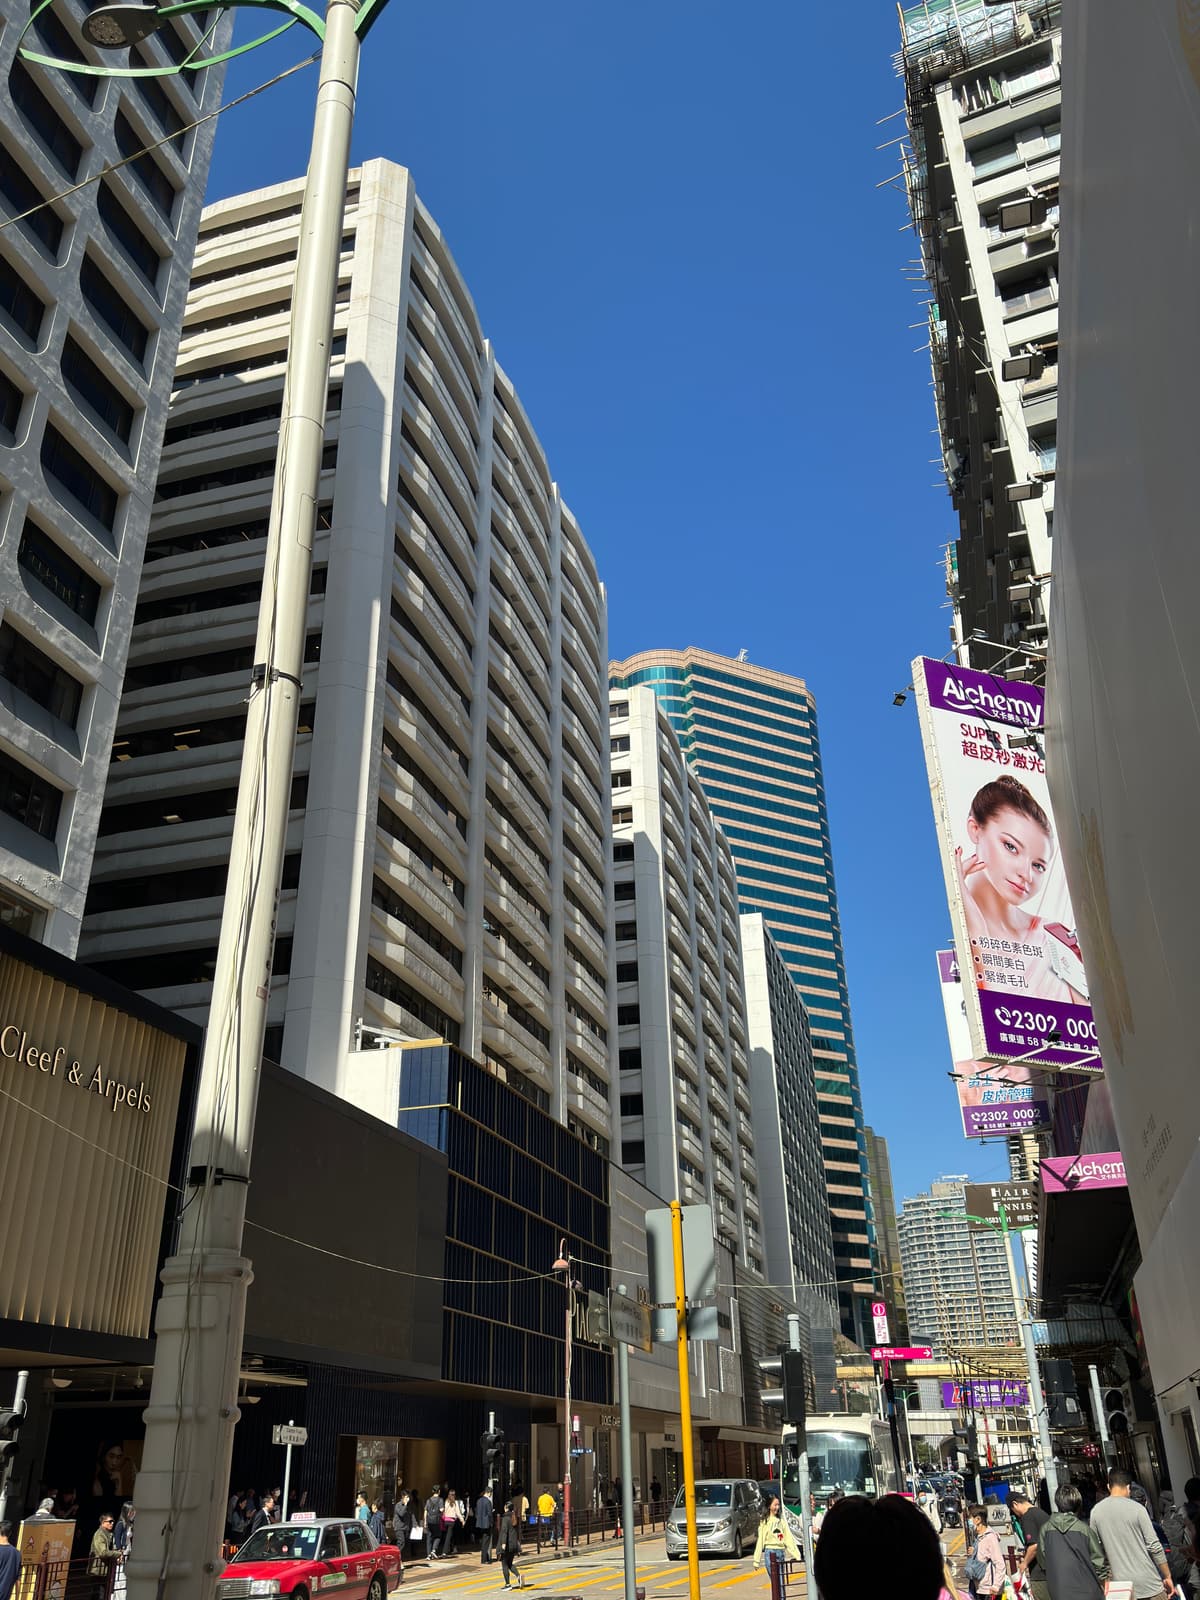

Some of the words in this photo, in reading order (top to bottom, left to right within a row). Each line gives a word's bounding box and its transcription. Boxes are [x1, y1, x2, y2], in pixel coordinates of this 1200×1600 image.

[943, 677, 1041, 727] Alchemy
[960, 723, 1002, 745] SUPER
[961, 739, 1045, 773] 超皮秒激光
[979, 936, 1043, 958] 粉碎色素色斑
[982, 953, 1025, 970] 瞬間美白
[1012, 1009, 1057, 1033] 2302
[1027, 1036, 1039, 1047] 58
[0, 1025, 66, 1076] Cleef
[68, 1060, 84, 1086] &
[88, 1064, 151, 1113] Arpels
[982, 1087, 1034, 1103] 皮膚管理
[980, 1110, 1008, 1122] 2302
[1013, 1108, 1041, 1119] 0002
[991, 1187, 1031, 1197] HAIR
